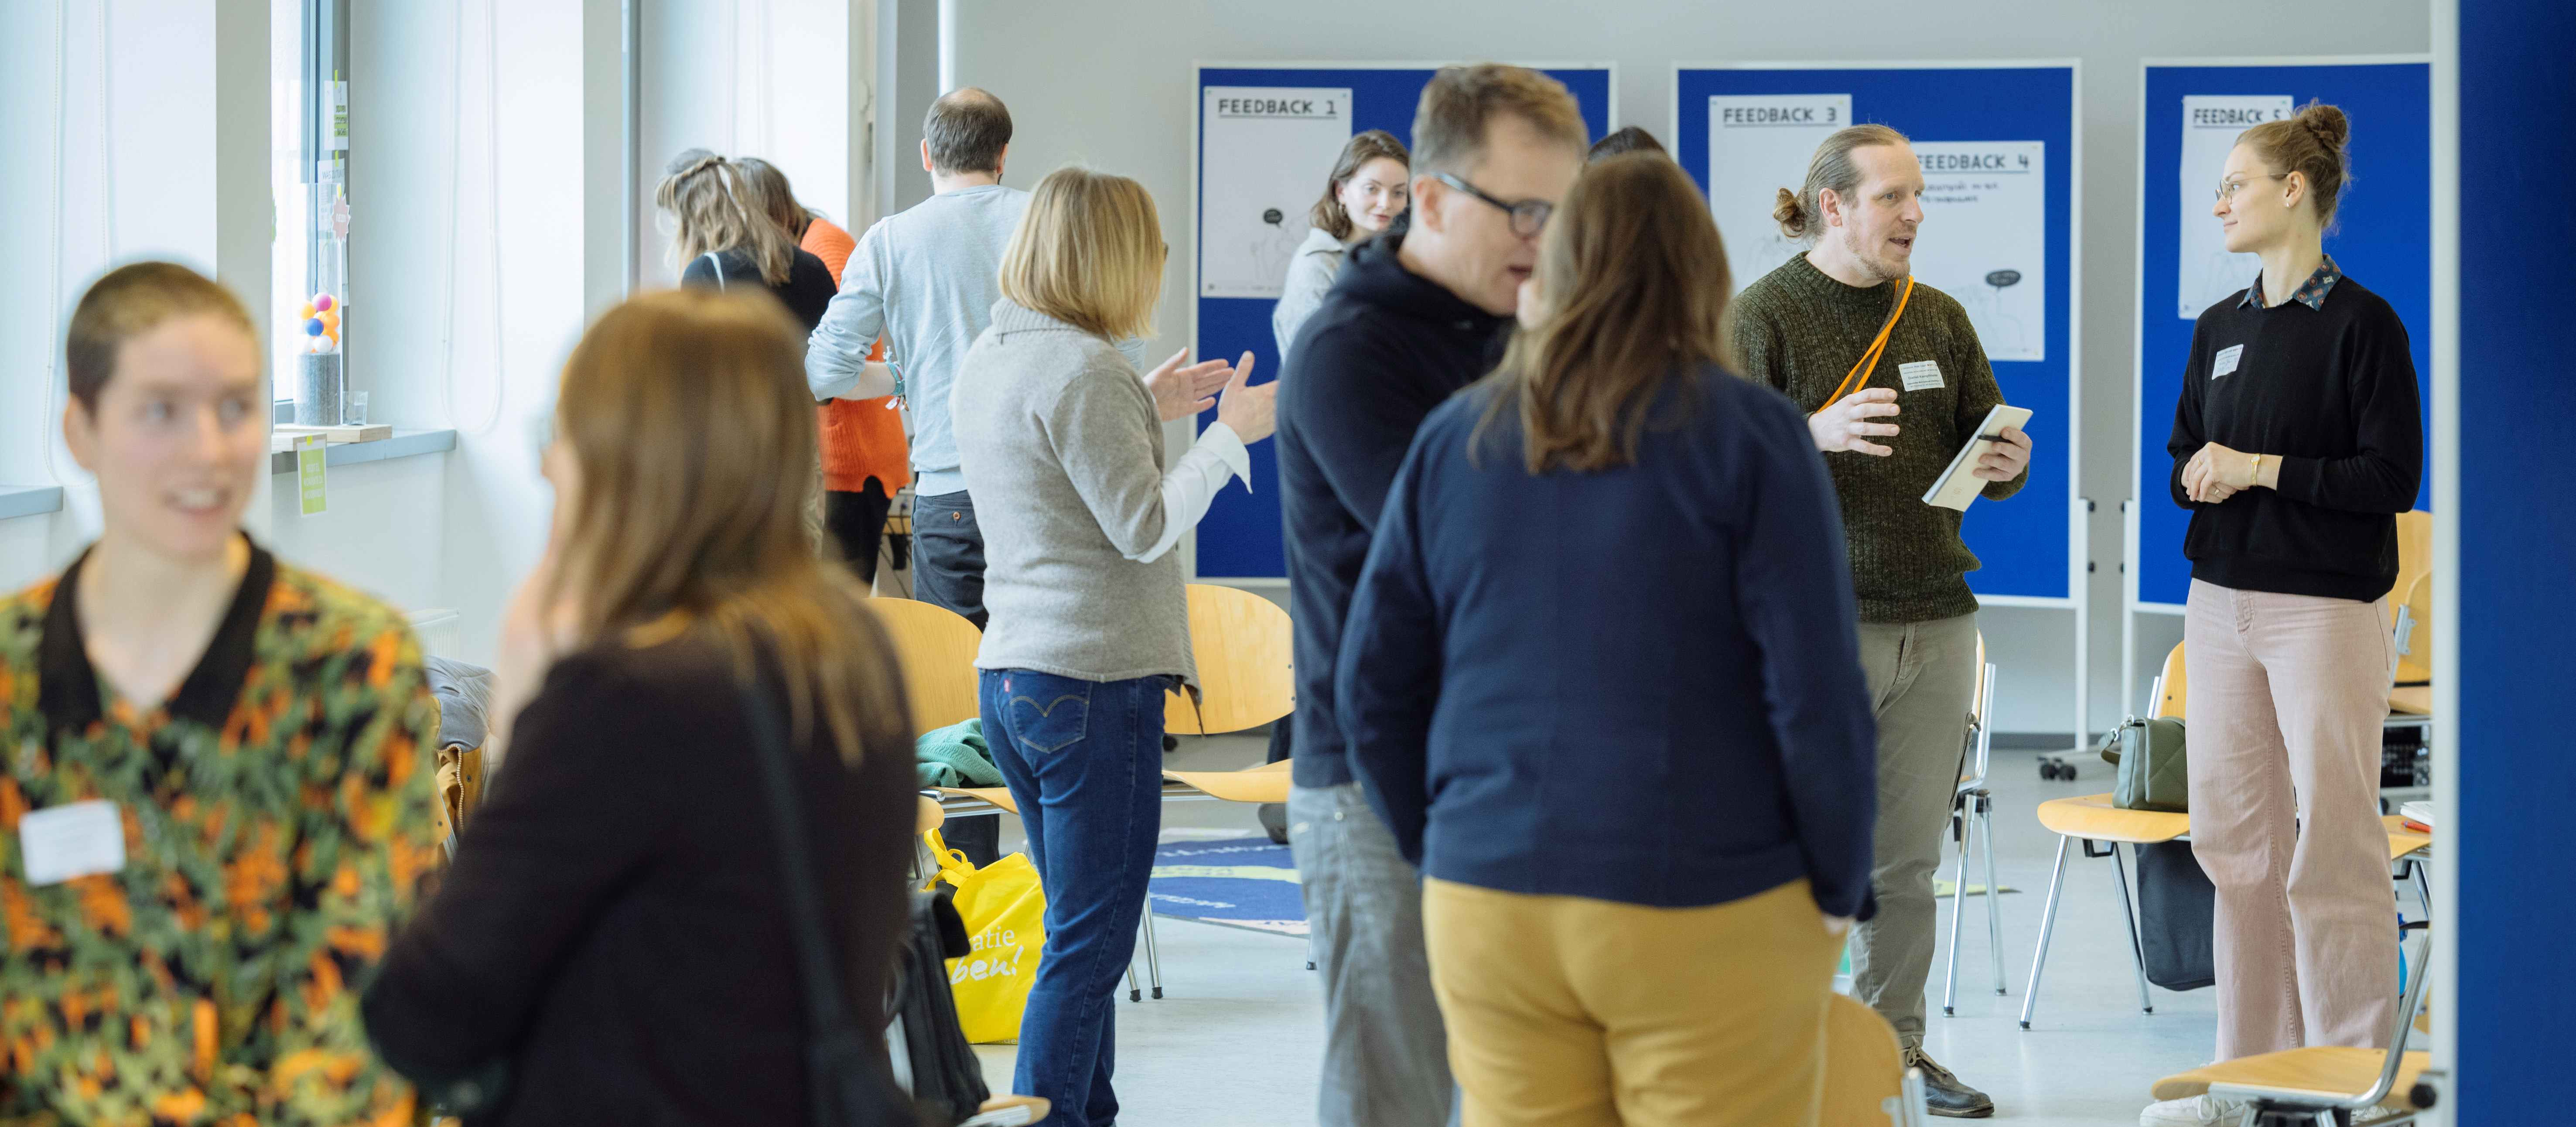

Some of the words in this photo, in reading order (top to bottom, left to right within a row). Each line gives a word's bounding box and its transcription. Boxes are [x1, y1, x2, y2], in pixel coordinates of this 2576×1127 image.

[1218, 99, 1313, 114] FEEDBACK
[1326, 100, 1337, 115] 1
[1723, 108, 1814, 122] FEEDBACK
[1827, 107, 1837, 122] 3
[2193, 109, 2263, 124] FEEDBACK
[2018, 153, 2029, 169] 4
[972, 926, 1016, 952] atie
[950, 944, 1025, 985] ben!
